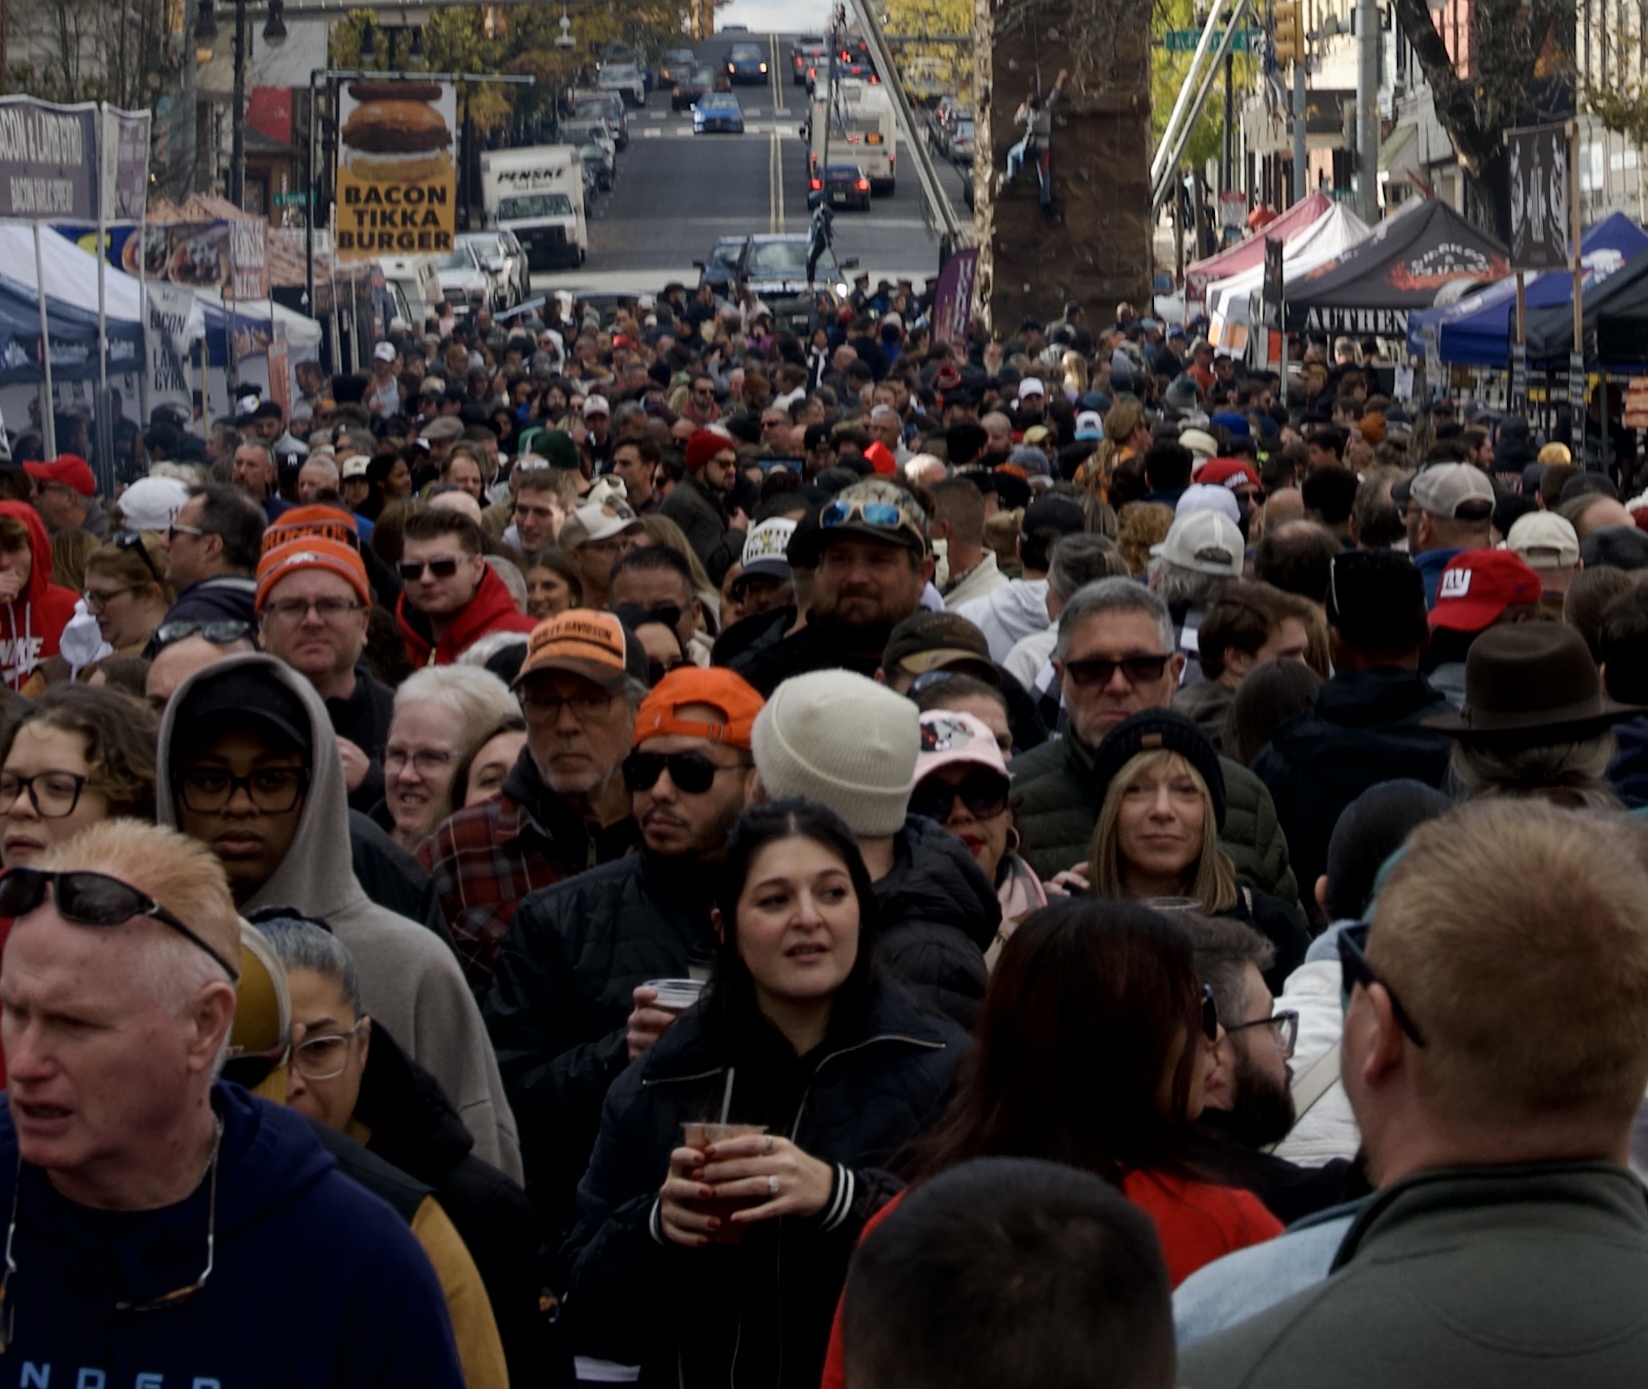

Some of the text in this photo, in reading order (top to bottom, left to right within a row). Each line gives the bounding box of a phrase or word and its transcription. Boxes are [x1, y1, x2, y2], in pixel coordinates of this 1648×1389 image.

[27, 115, 37, 161] &
[345, 185, 447, 205] BACON
[353, 209, 441, 228] TIKKA
[339, 231, 451, 250] BURGER
